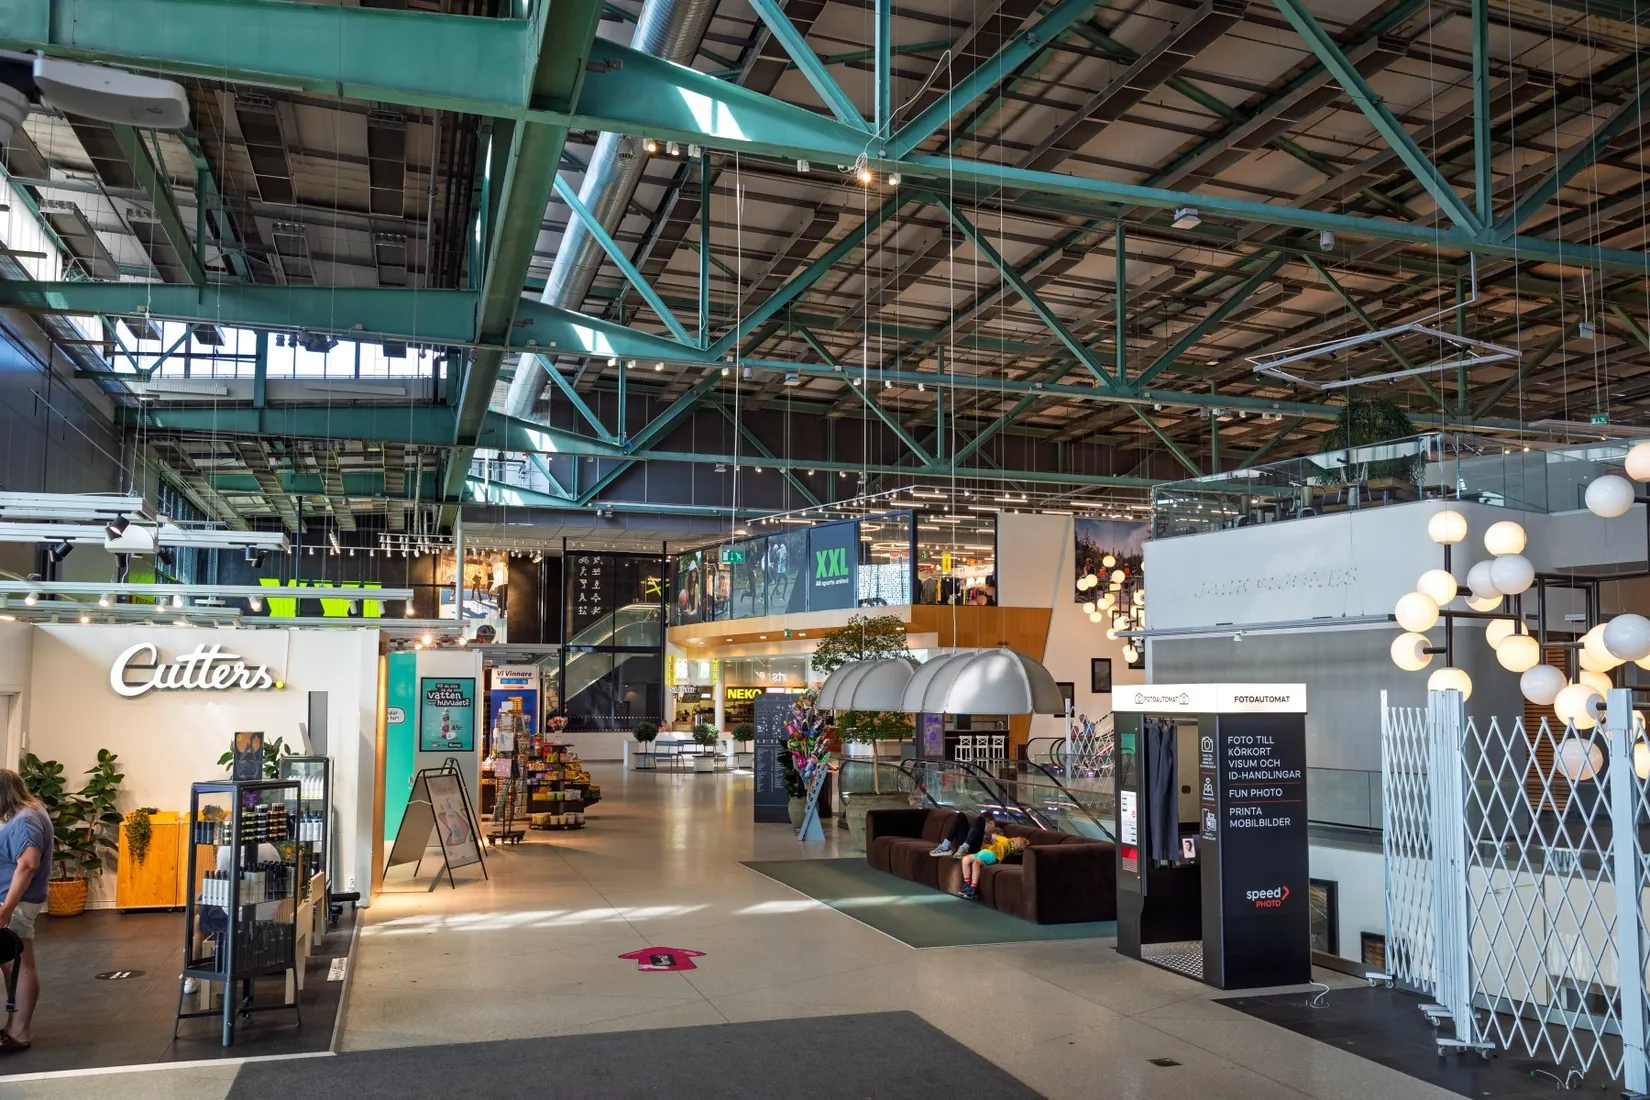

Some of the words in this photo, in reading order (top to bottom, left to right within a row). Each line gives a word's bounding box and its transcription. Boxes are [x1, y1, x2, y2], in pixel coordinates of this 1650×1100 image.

[815, 547, 849, 579] XXL
[822, 579, 835, 588] sports
[835, 577, 849, 585] united
[428, 692, 462, 700] vatten
[437, 698, 470, 706] huvudet?
[1227, 736, 1254, 745] FOTO
[1256, 735, 1275, 744] TILL
[1228, 747, 1272, 757] KÖRKORT
[1228, 759, 1258, 768] VISUM
[1260, 759, 1281, 767] OCH
[1228, 770, 1301, 780] ID-HANDLINGAR
[1229, 789, 1248, 798] FUN
[1250, 788, 1283, 797] PHOTO
[1229, 807, 1263, 816] PRINTA
[1229, 817, 1291, 828] MOBILBILDER
[1246, 886, 1282, 902] speed
[1256, 899, 1282, 908] PHOTO
